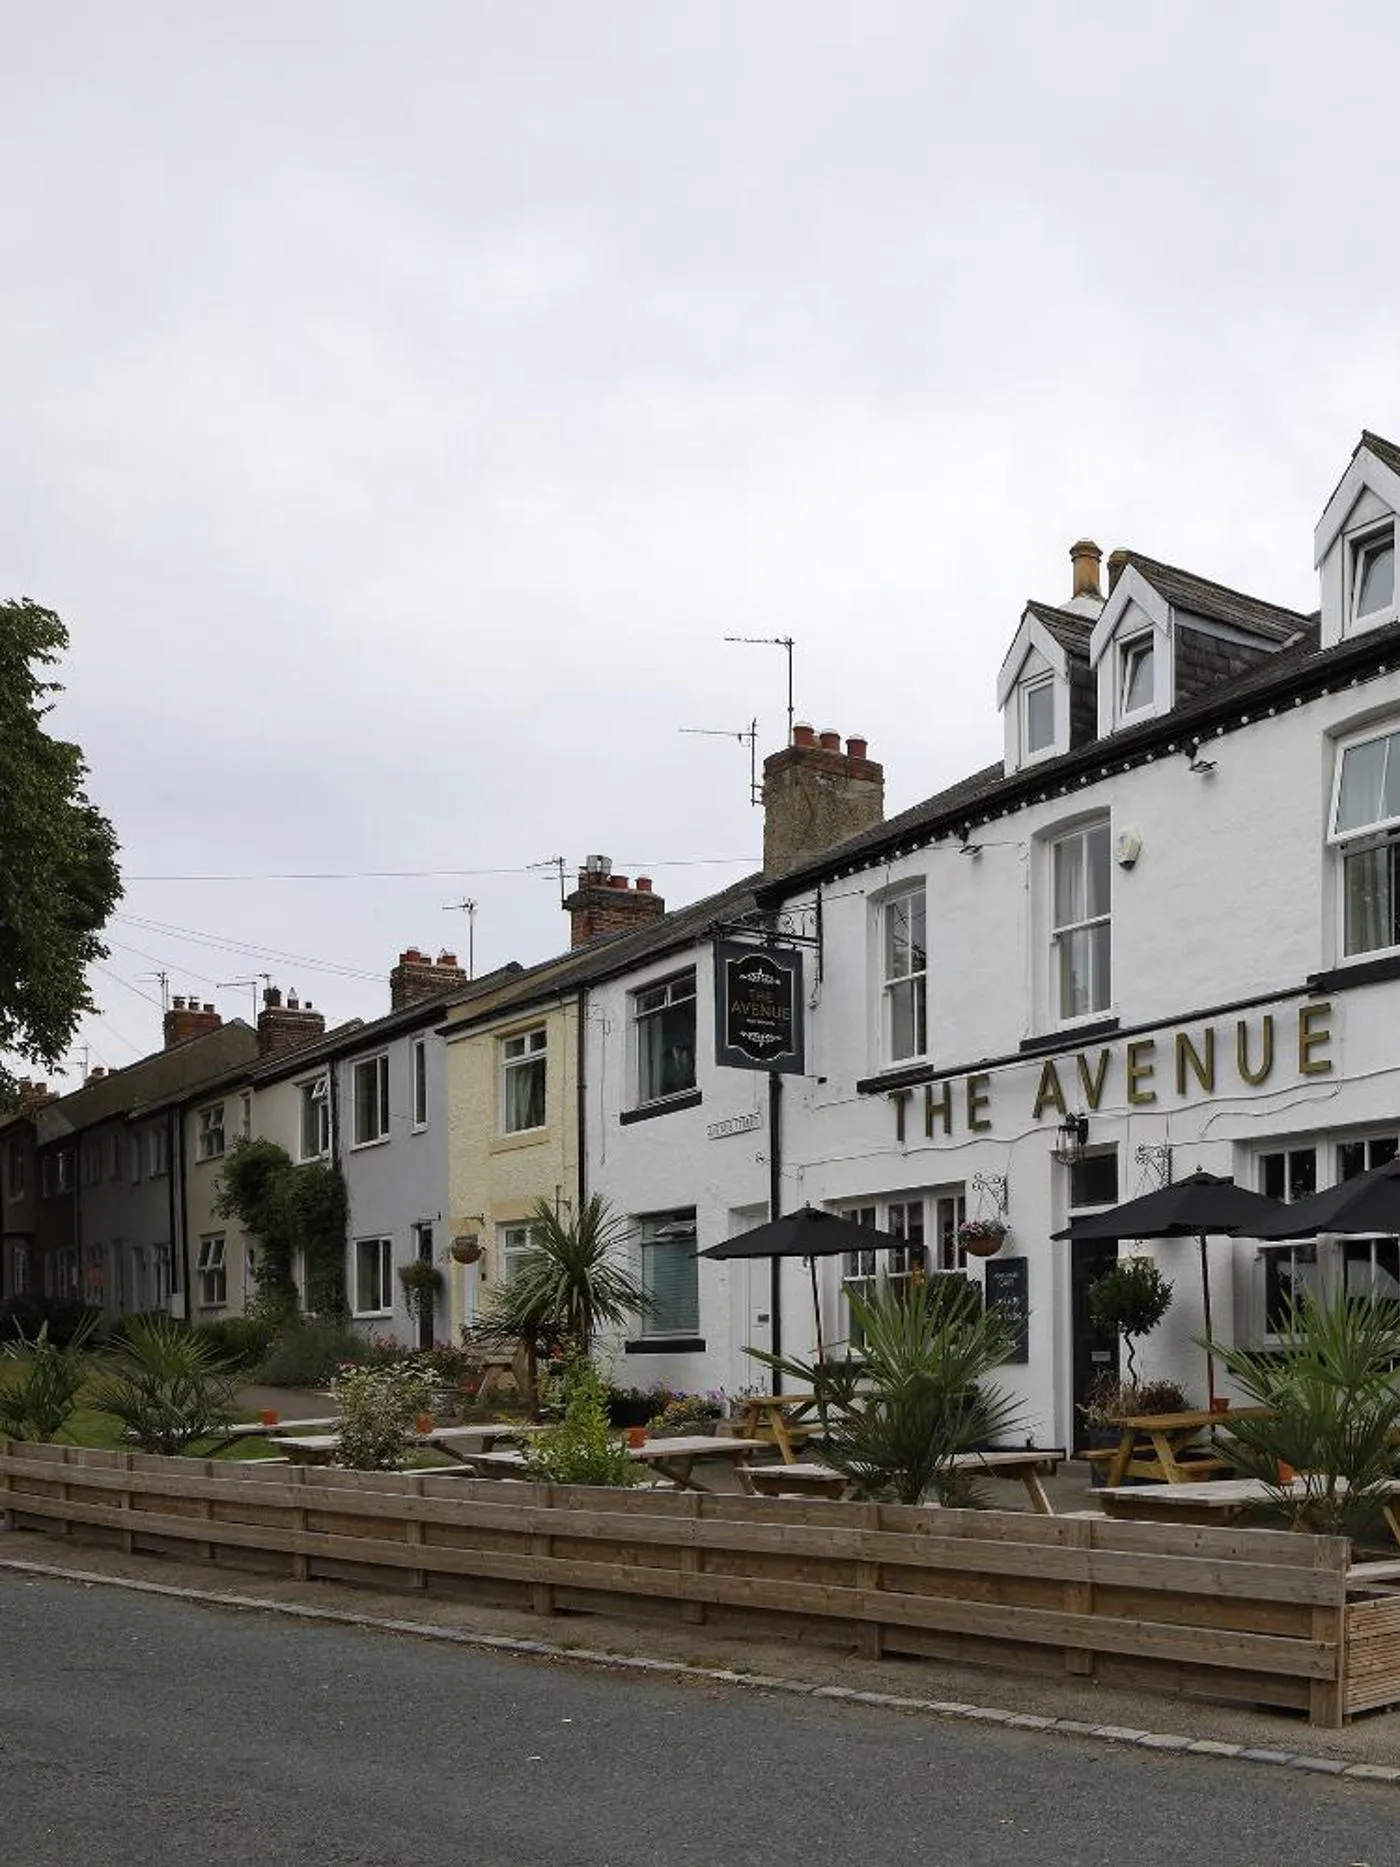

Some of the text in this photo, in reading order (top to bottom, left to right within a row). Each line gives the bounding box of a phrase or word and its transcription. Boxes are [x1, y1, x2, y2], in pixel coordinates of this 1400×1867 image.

[731, 1000, 791, 1020] AVENUE
[889, 1002, 1332, 1142] THE AVENUE
